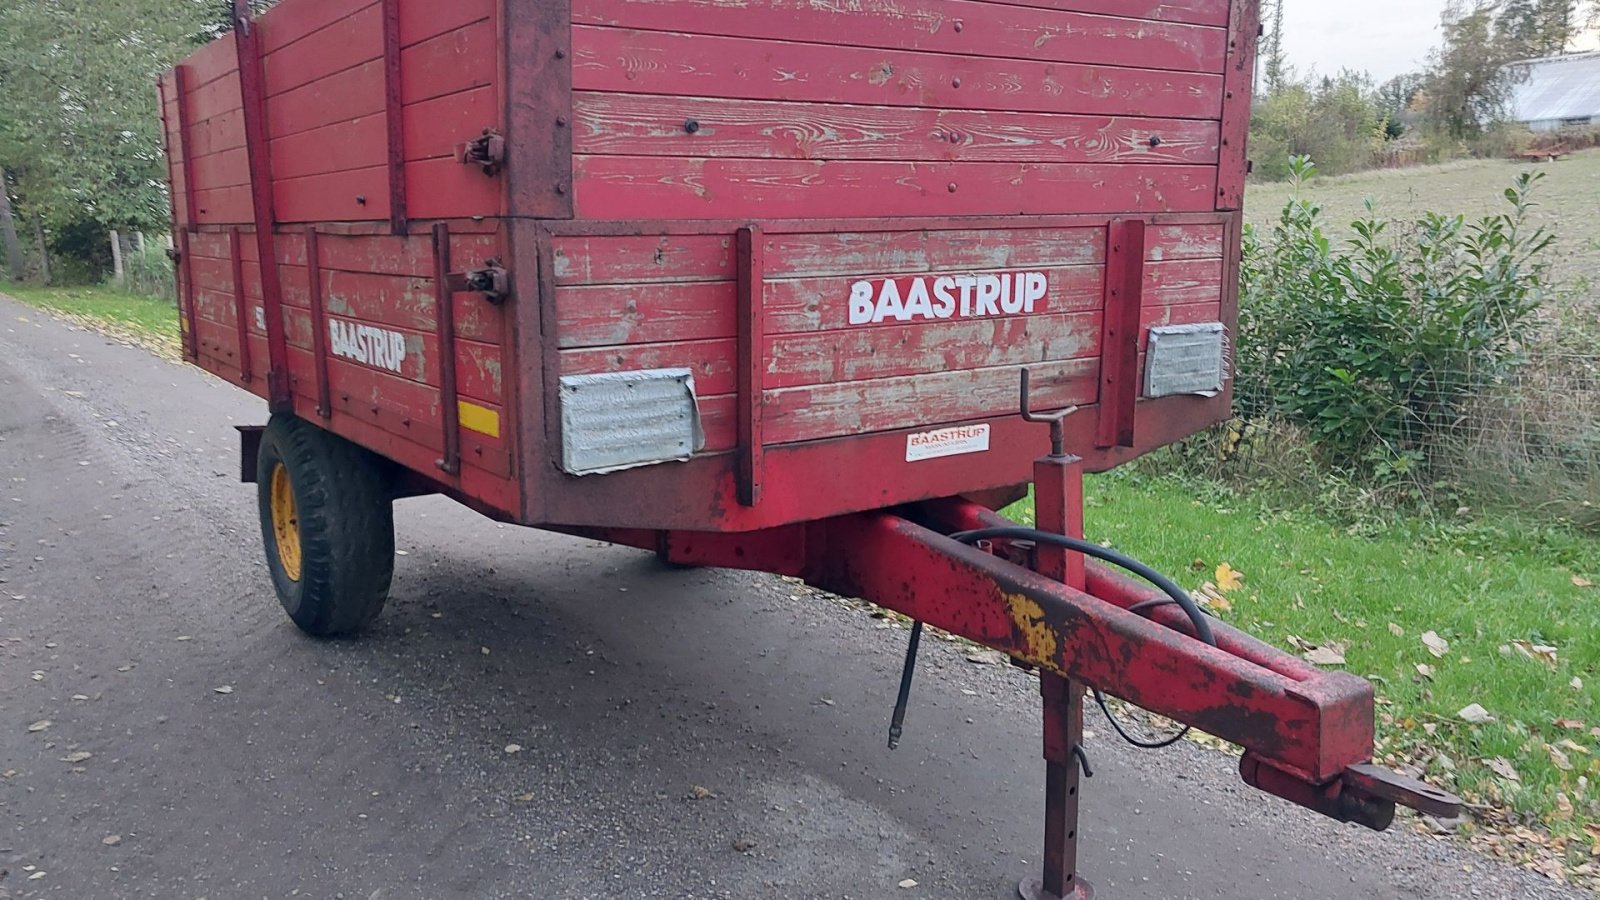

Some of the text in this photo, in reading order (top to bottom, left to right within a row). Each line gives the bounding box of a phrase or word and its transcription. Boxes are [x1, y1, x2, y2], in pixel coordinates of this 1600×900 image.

[849, 272, 1047, 324] BAASTRUP
[329, 318, 405, 373] BAASTRUP
[911, 428, 985, 446] BAASTRUP
